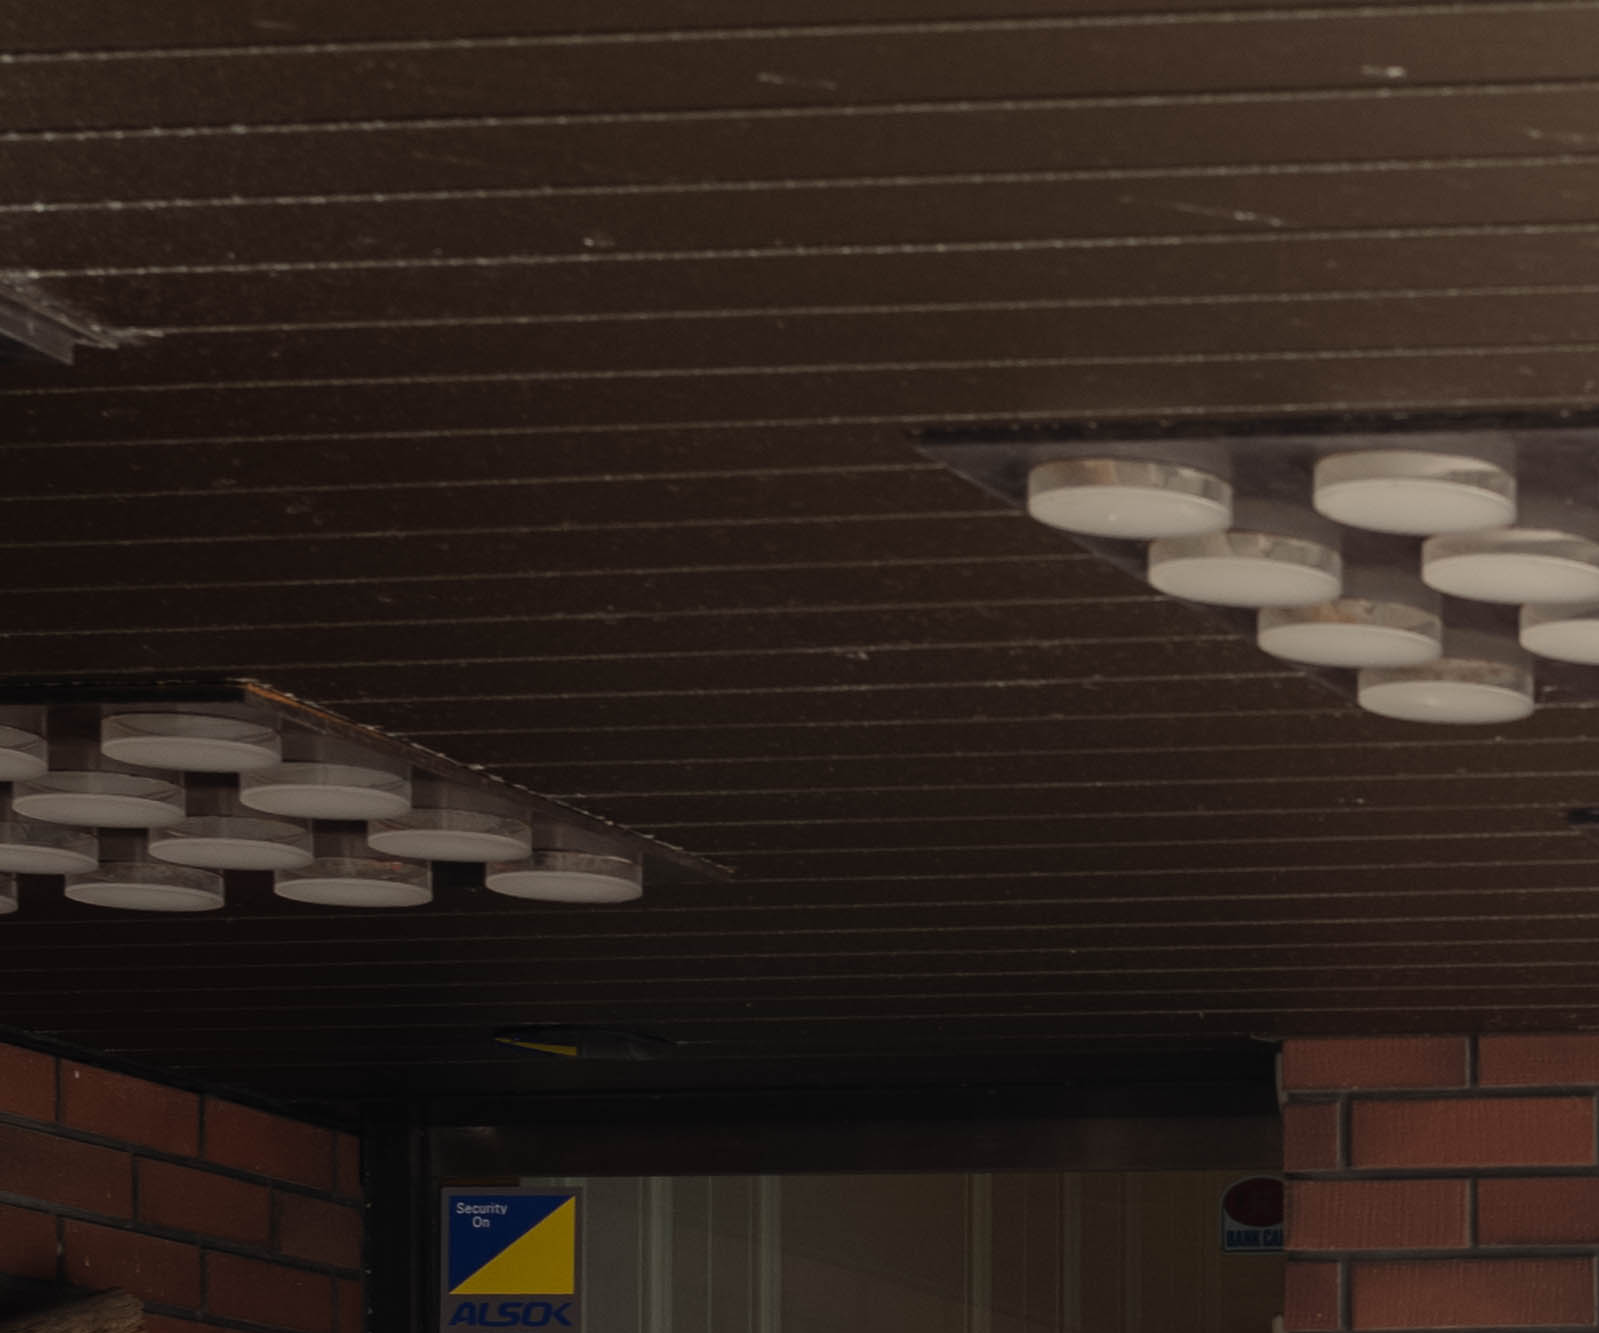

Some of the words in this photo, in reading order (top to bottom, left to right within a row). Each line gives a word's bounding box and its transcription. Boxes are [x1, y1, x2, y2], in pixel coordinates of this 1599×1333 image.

[456, 1202, 508, 1216] Security
[472, 1216, 491, 1228] On
[450, 1301, 574, 1327] ALSOK
